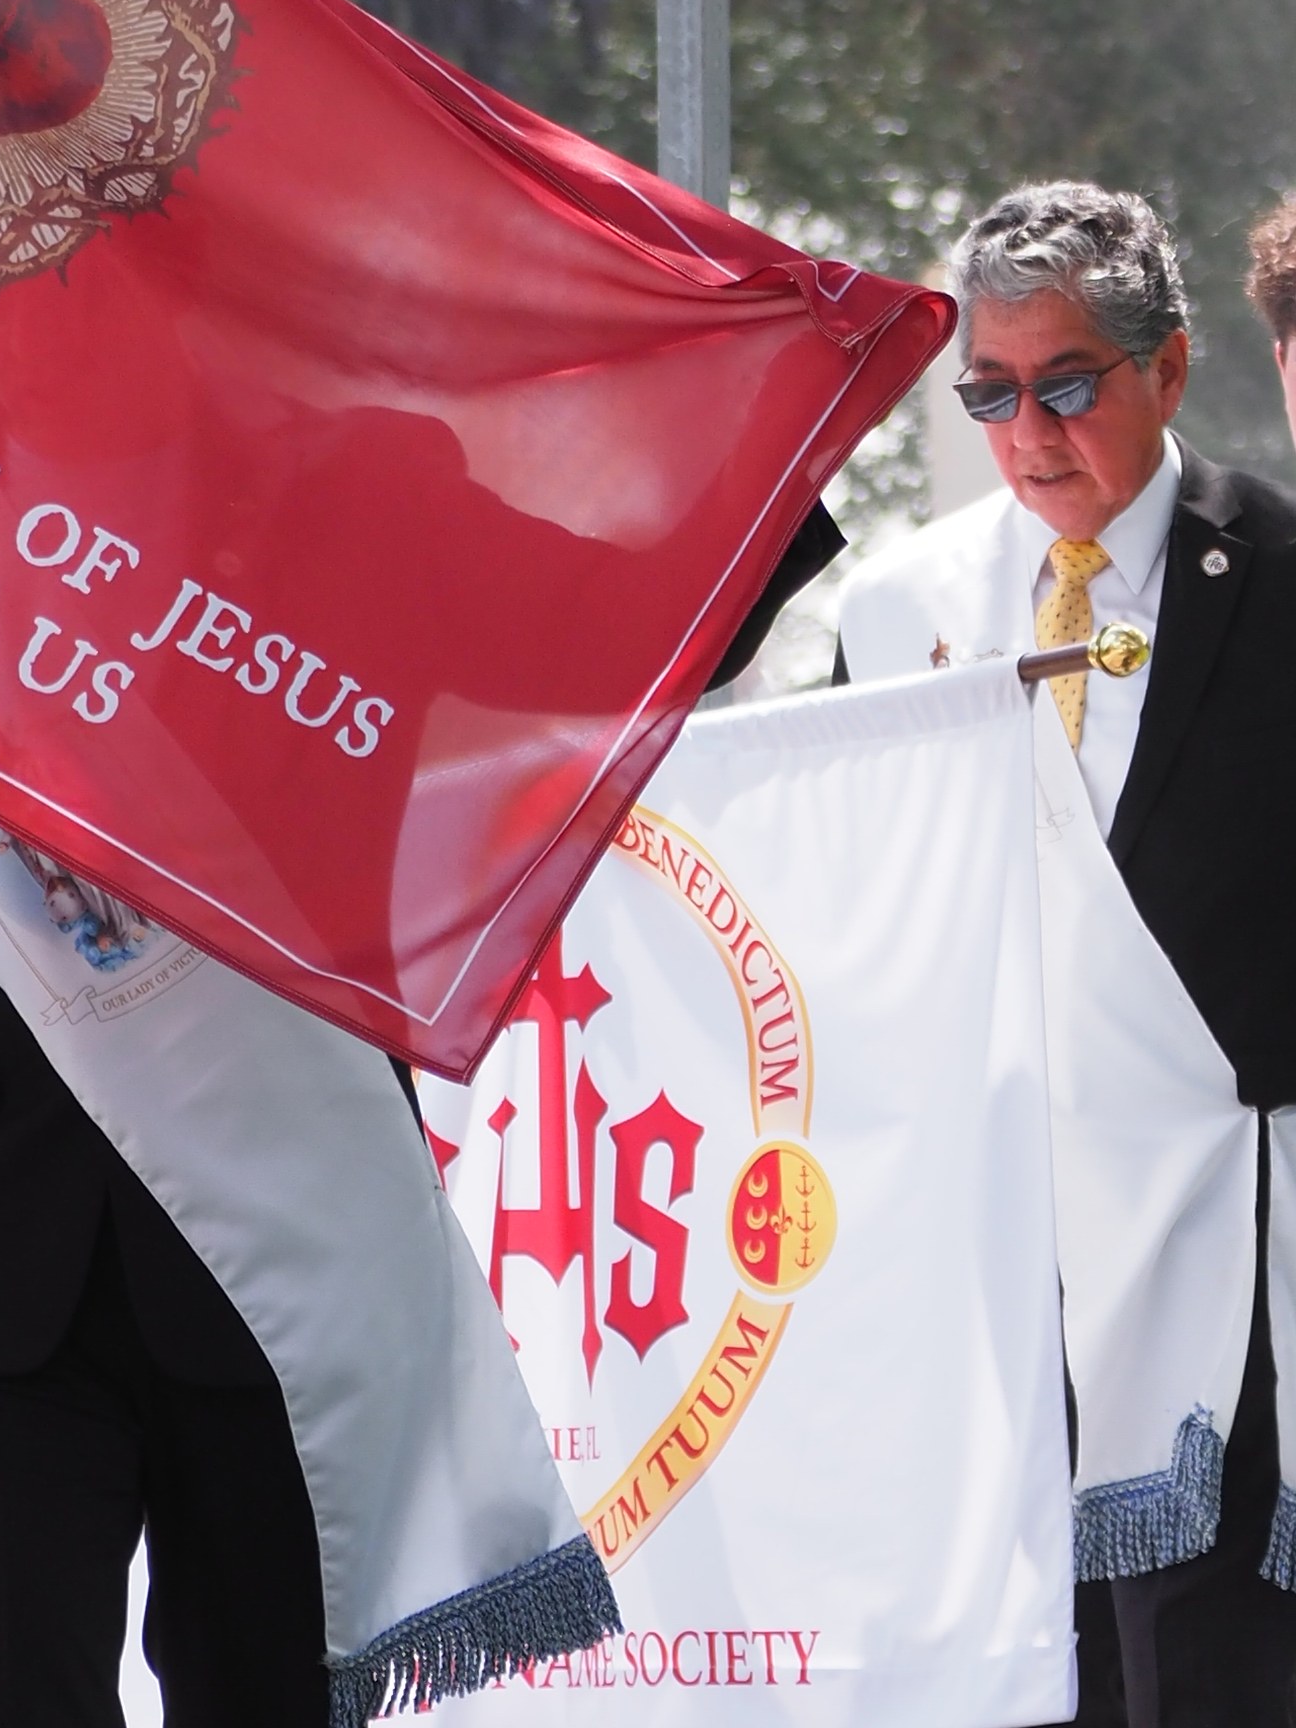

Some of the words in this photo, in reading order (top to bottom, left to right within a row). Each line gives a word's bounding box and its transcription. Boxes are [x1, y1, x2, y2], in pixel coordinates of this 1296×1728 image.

[16, 504, 140, 595] OF
[131, 578, 395, 758] JESUS
[19, 615, 135, 724] US
[102, 993, 129, 1012] OUR
[126, 978, 156, 1001] LADY
[154, 968, 171, 984] OF
[613, 813, 800, 1110] BENEDICTUM
[646, 1313, 770, 1493] TUUM
[623, 1629, 819, 1687] SOCIETY
